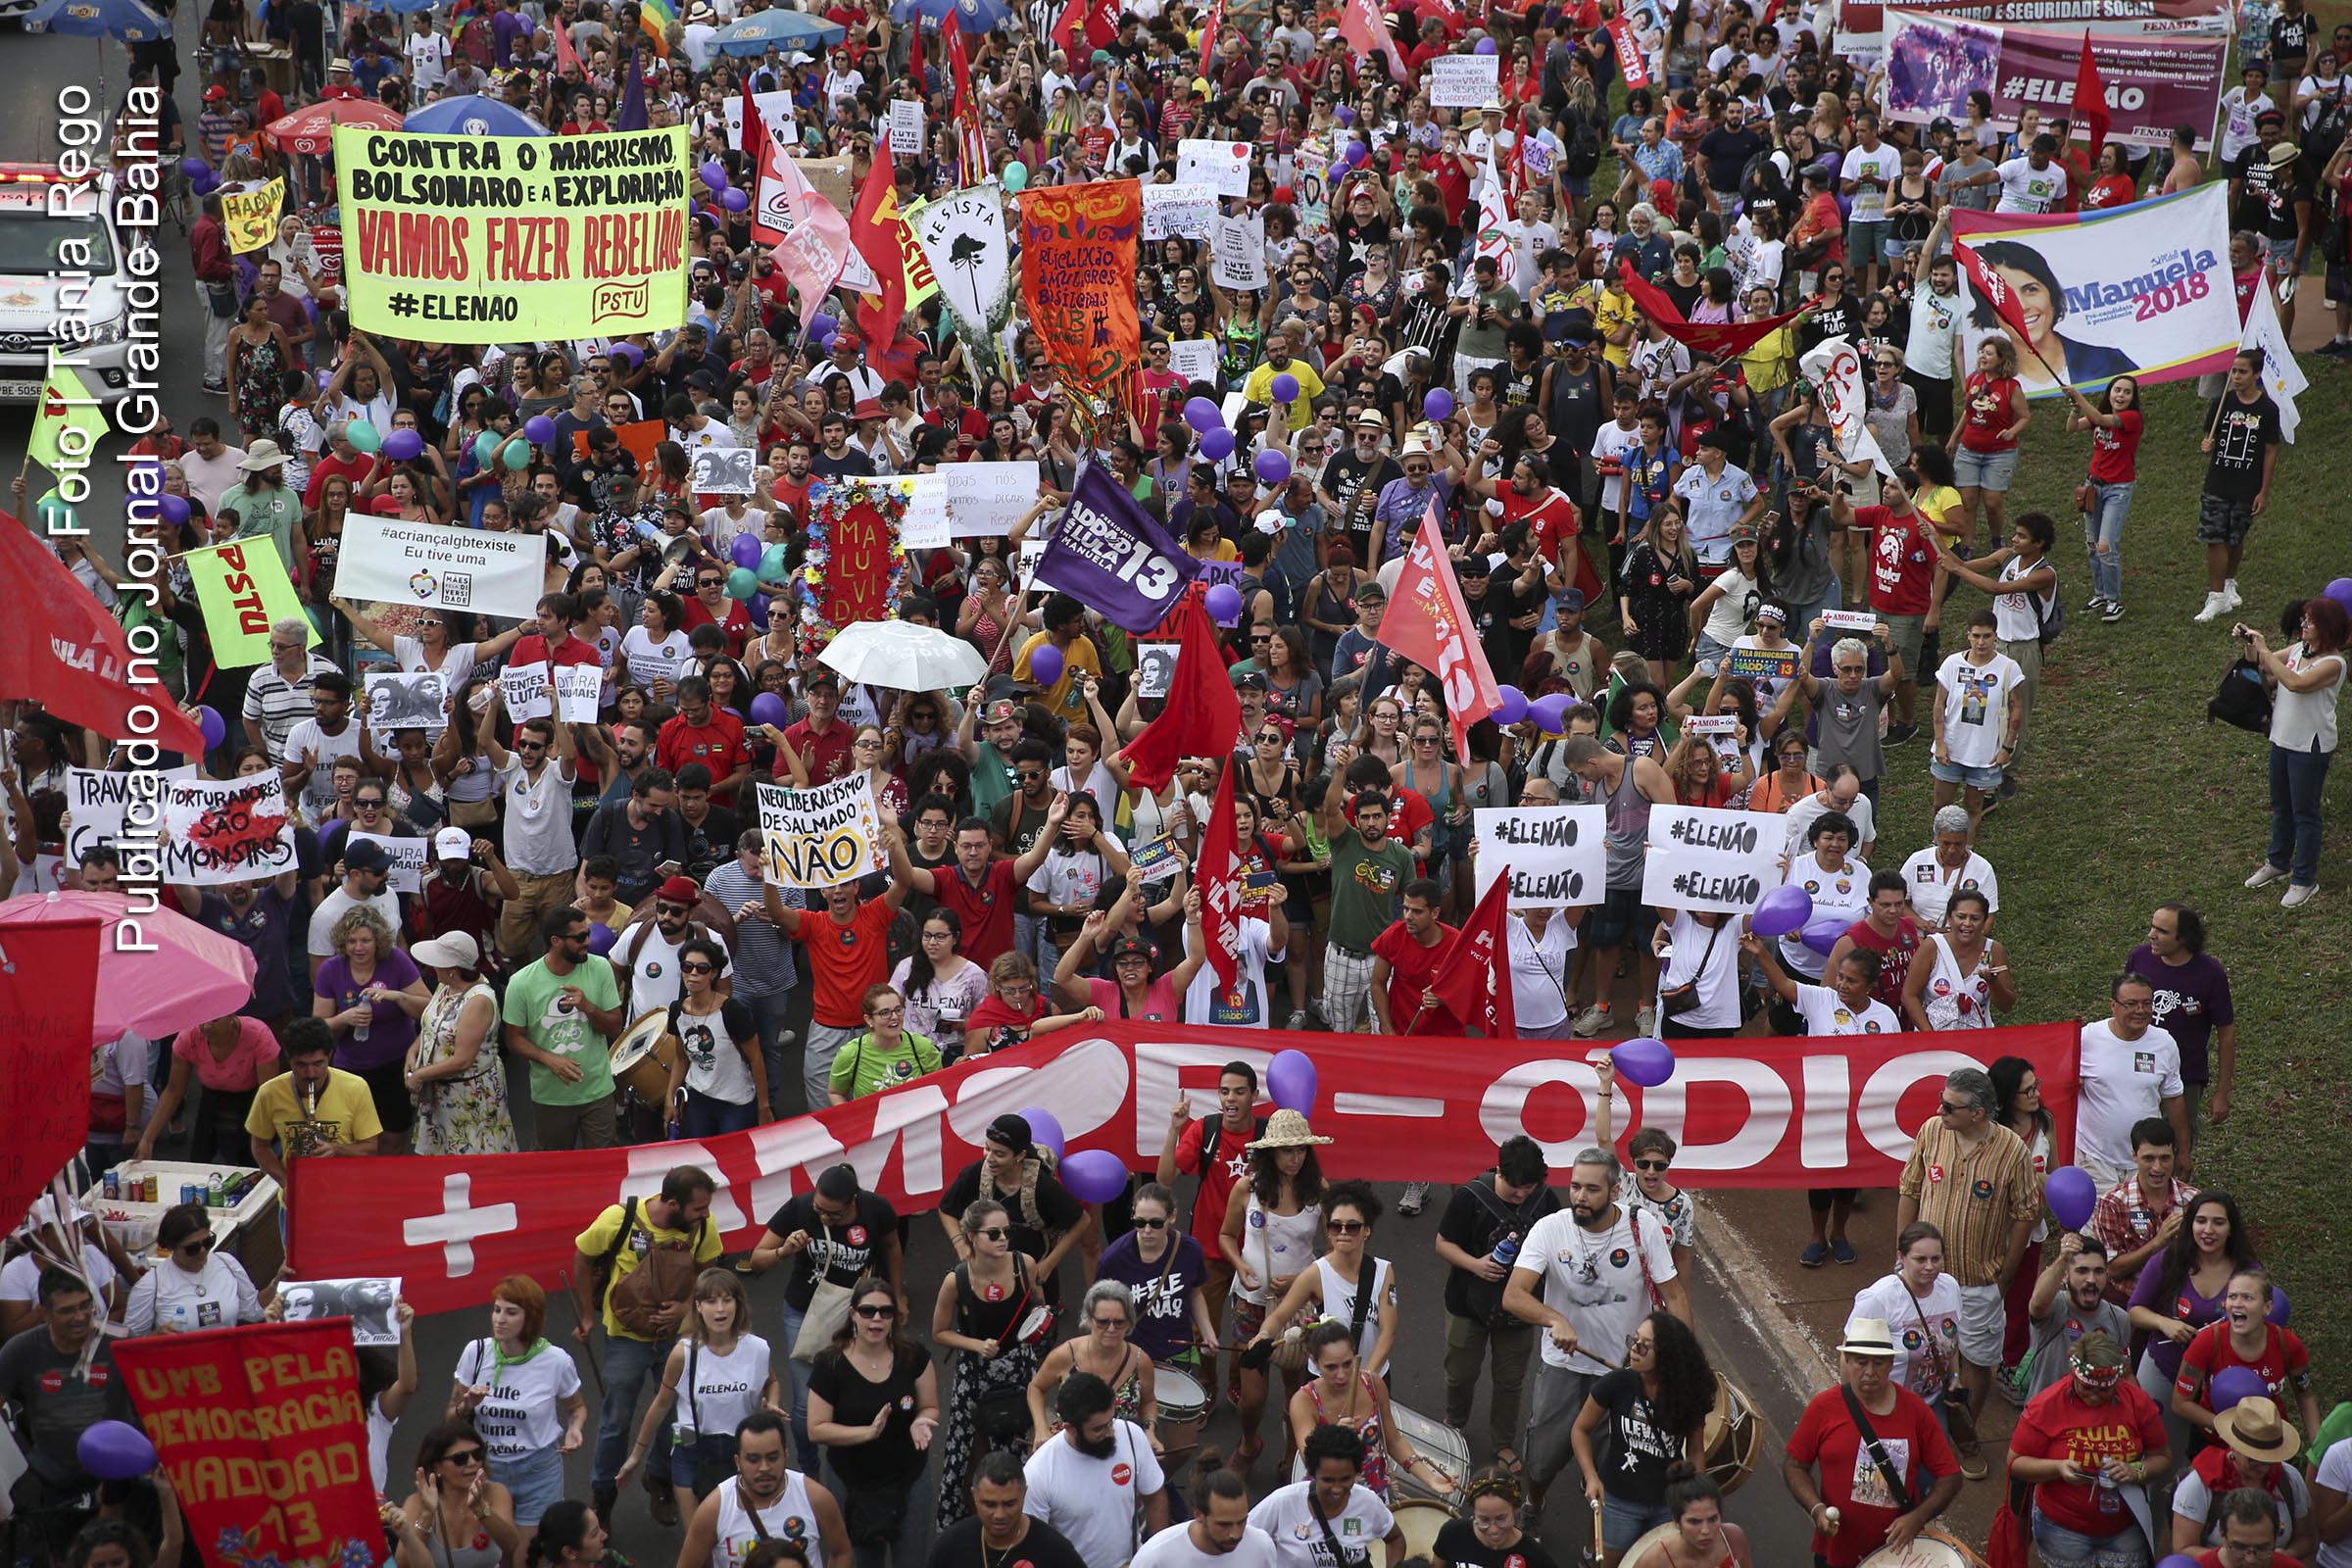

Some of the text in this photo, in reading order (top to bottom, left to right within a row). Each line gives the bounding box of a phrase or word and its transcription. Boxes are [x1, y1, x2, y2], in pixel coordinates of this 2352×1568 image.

[2005, 2, 2099, 21] SEGURIDADE
[2142, 20, 2199, 32] FENASPS
[2121, 47, 2152, 57] mundo
[2153, 48, 2178, 58] onde
[2179, 51, 2218, 61] sejamos
[1623, 63, 1642, 82] 13
[2002, 75, 2145, 111] #ELEÃO
[368, 135, 502, 171] CONTRA
[517, 142, 537, 170] O
[353, 165, 684, 207] BOLSONARO E A EXPLORAÇÃO
[762, 215, 795, 231] CENTRA
[925, 200, 996, 247] RESISTA
[357, 208, 469, 281] VAMOS
[486, 217, 570, 282] FAZER
[1225, 259, 1251, 270] LUTE
[2063, 248, 2218, 315] Manuela
[2132, 271, 2210, 322] 2018
[600, 290, 644, 312] PSTU
[381, 526, 516, 553] #acriançalgbtexiste
[1070, 500, 1132, 556] ADDAD
[1100, 513, 1135, 541] PRESIDENTE
[404, 545, 487, 565] Eu tive uma
[1061, 538, 1114, 572] MANUELA
[1071, 526, 1120, 565] LULA
[446, 575, 468, 585] MÃES
[1116, 539, 1179, 601] 13
[217, 545, 270, 635] PSTU
[444, 595, 467, 605] DADE
[1433, 583, 1458, 630] ESIDENTE
[1833, 613, 1856, 622] AMOR
[1738, 649, 1794, 660] PELA DEMOCRACIA
[1780, 663, 1792, 675] 13
[1697, 718, 1720, 728] AMOR
[169, 776, 282, 808] TORTURADORES
[759, 773, 865, 812] NEOLIBERALISMO
[198, 807, 251, 839] SÃO
[762, 803, 858, 833] DESALMADO
[1494, 814, 1579, 848] #ELENÃO
[169, 823, 293, 879] MONSTROS
[1670, 816, 1758, 855] #ELENÃO
[769, 833, 858, 883] NÃO
[1148, 863, 1166, 877] AMOR
[1672, 869, 1761, 906] #ELENÃO
[1229, 995, 1242, 1006] 13
[620, 1038, 1277, 1231] AMOR
[1232, 1163, 1247, 1174] PT
[1131, 1272, 1184, 1304] #ELE
[243, 1347, 354, 1394] PELA
[698, 1382, 748, 1395] #ELENÃO
[480, 1405, 527, 1421] como
[480, 1424, 516, 1438] uma
[2075, 1425, 2131, 1442] LULA
[167, 1444, 361, 1506] HADDAD
[258, 1501, 322, 1546] 13
